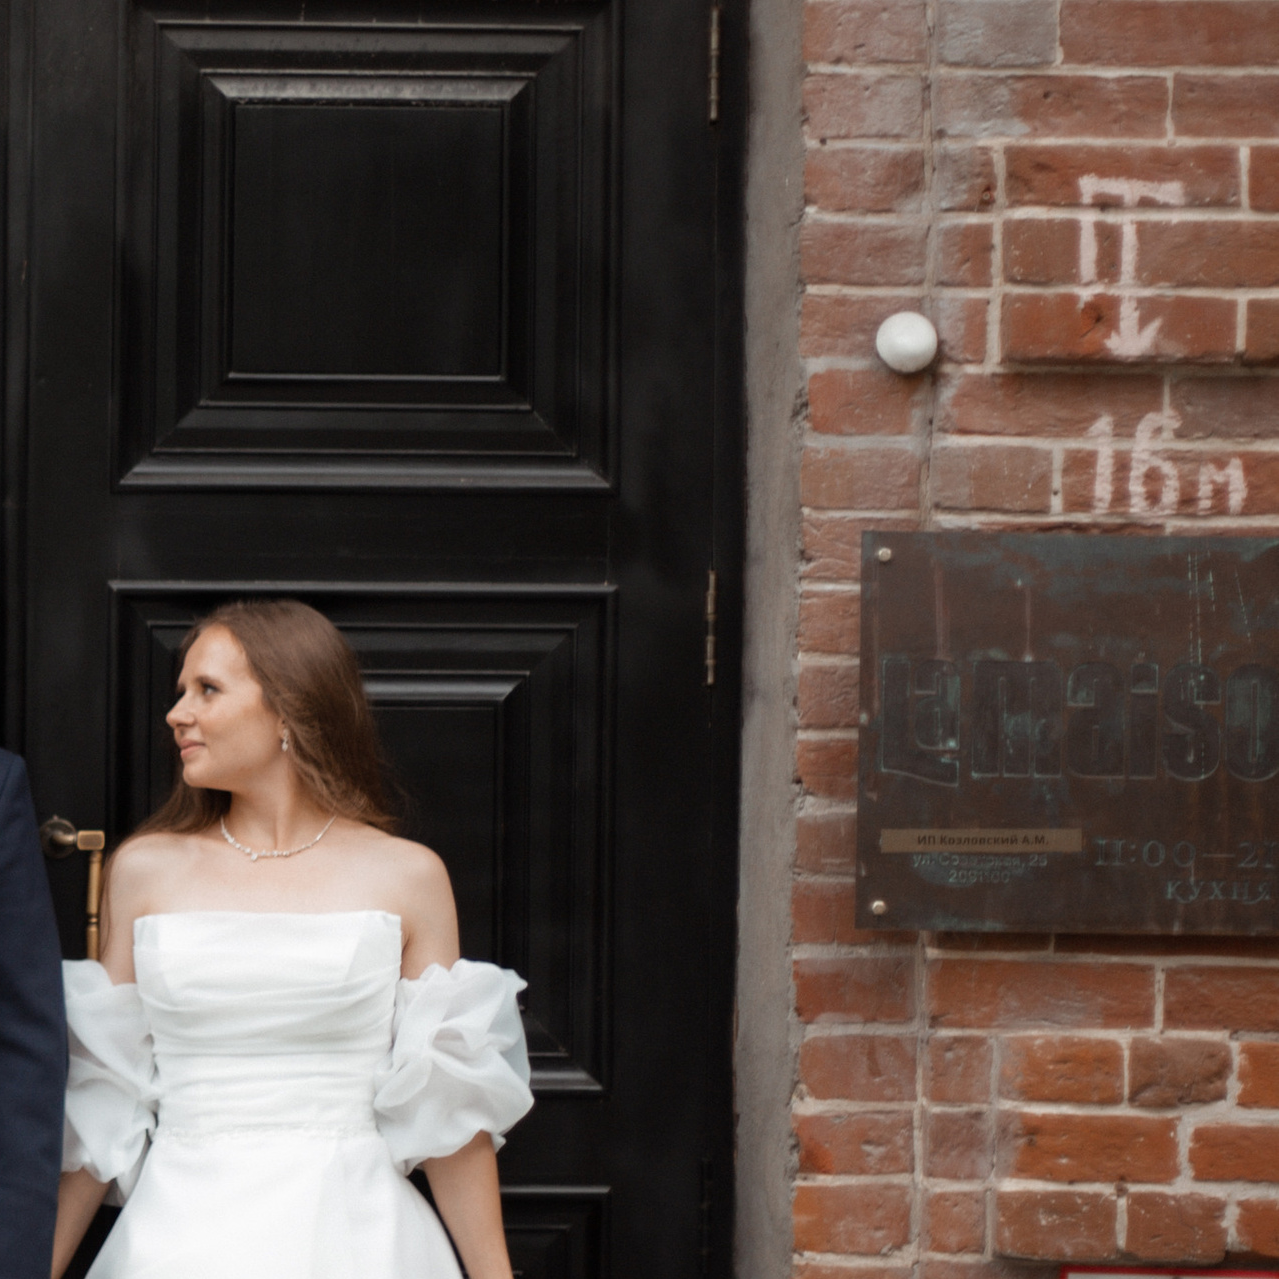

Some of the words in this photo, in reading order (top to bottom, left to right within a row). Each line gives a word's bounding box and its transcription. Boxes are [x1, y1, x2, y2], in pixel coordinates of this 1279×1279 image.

[917, 835, 936, 845] ИП
[939, 834, 1019, 845] Козловский
[1022, 835, 1050, 845] А.М.
[1165, 880, 1272, 905] КУХНЯ
